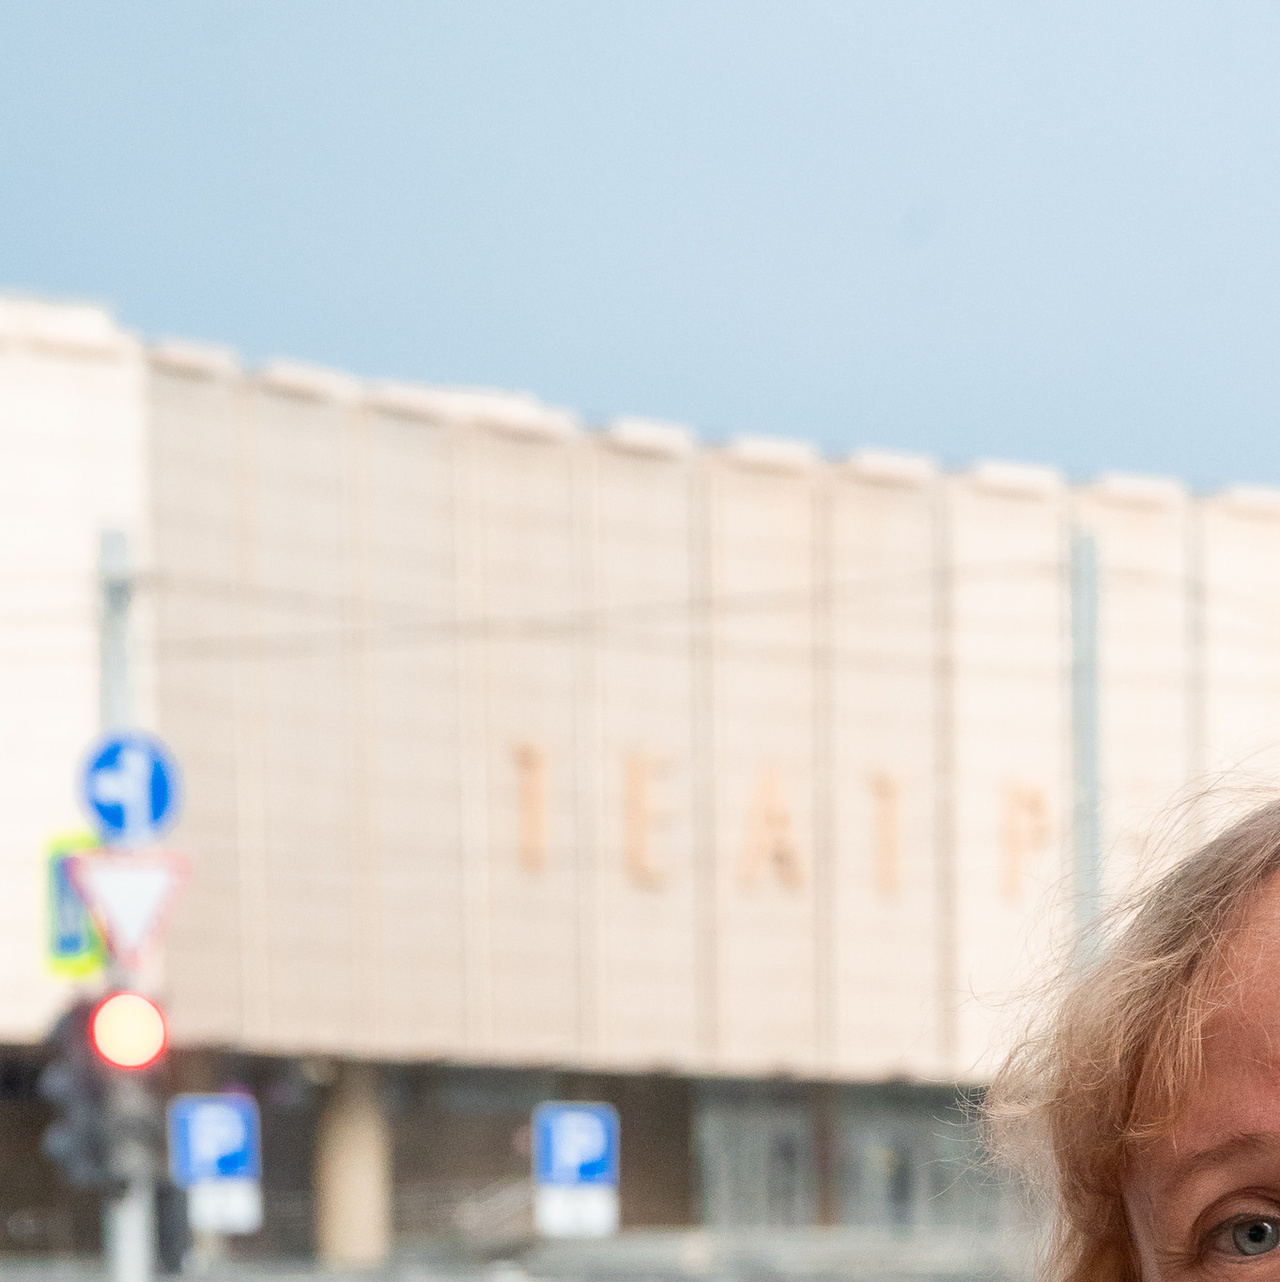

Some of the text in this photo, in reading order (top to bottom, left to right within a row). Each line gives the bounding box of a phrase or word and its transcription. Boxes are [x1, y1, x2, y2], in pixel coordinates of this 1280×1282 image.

[507, 738, 1053, 904] ТЕАТР
[189, 1103, 245, 1175] P
[552, 1111, 607, 1183] P
